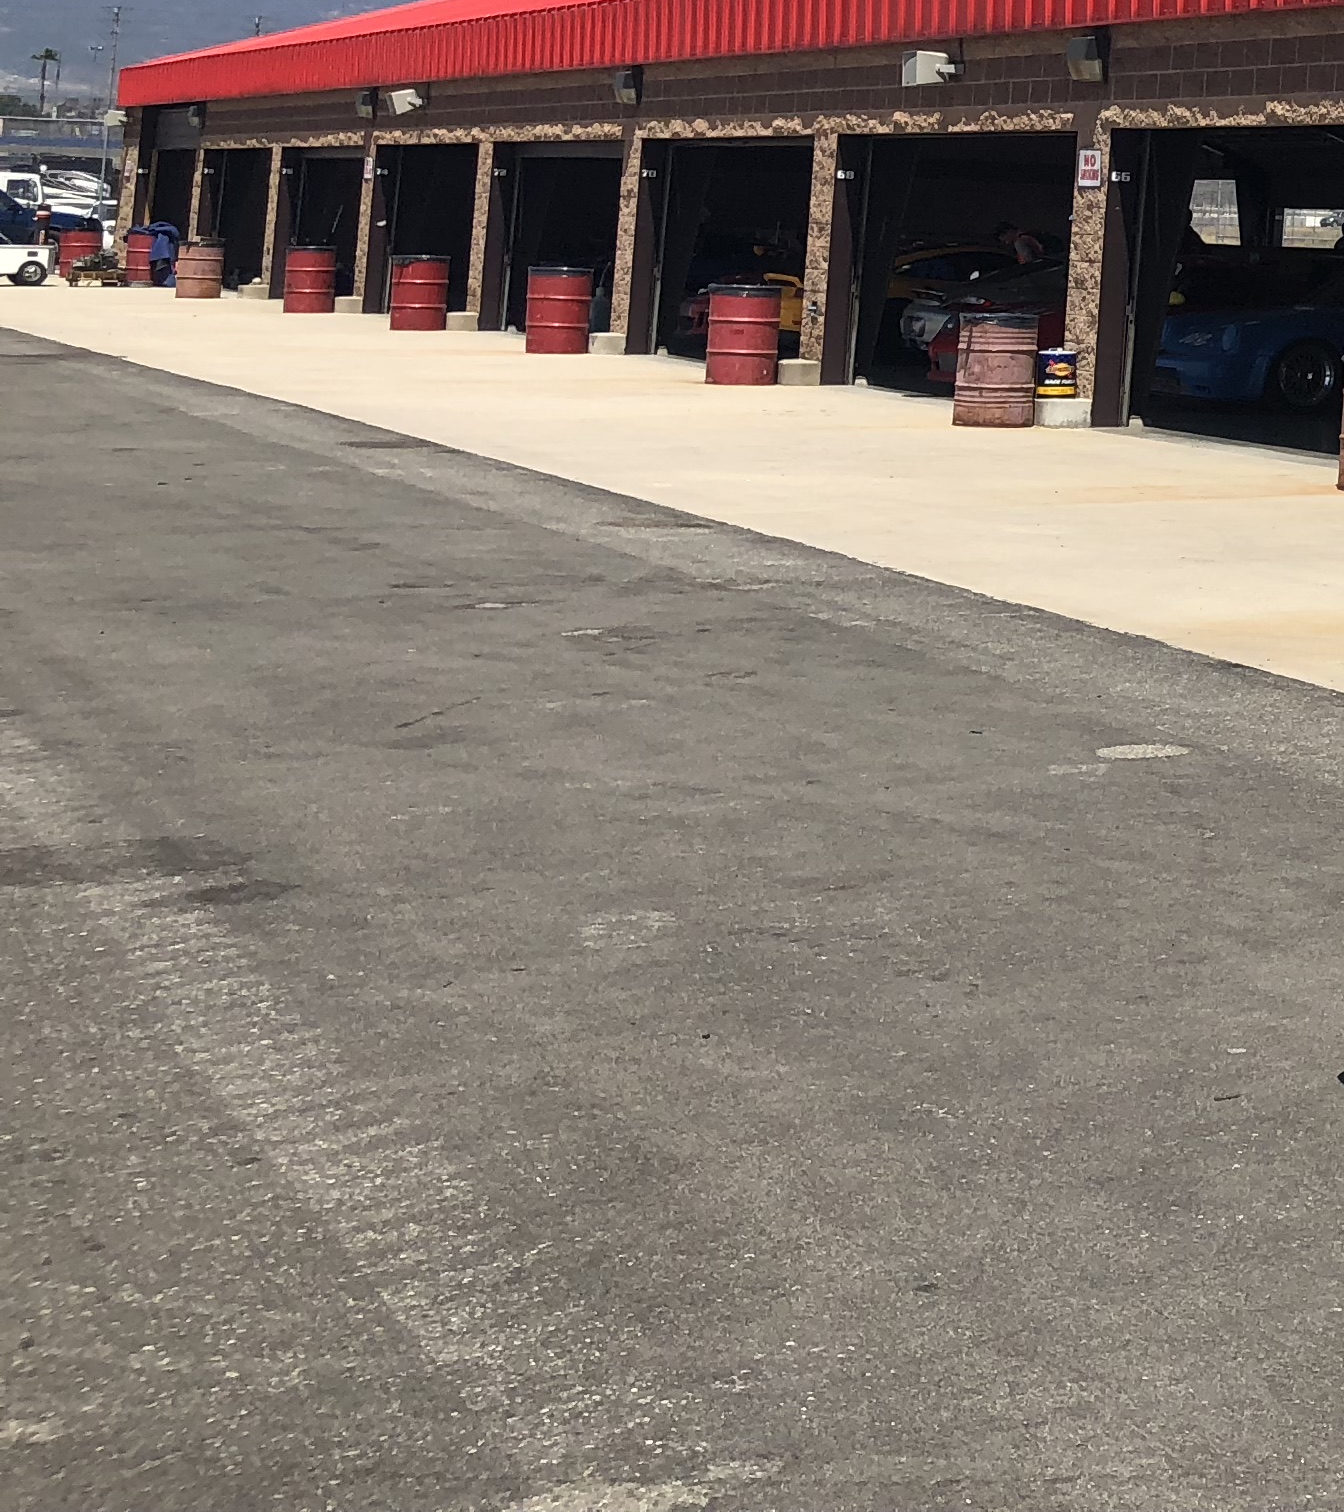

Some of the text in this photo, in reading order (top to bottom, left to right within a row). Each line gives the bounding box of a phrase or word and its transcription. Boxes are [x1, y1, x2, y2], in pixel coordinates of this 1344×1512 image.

[1084, 154, 1097, 167] NO
[837, 169, 855, 180] 68
[1111, 170, 1131, 182] 66
